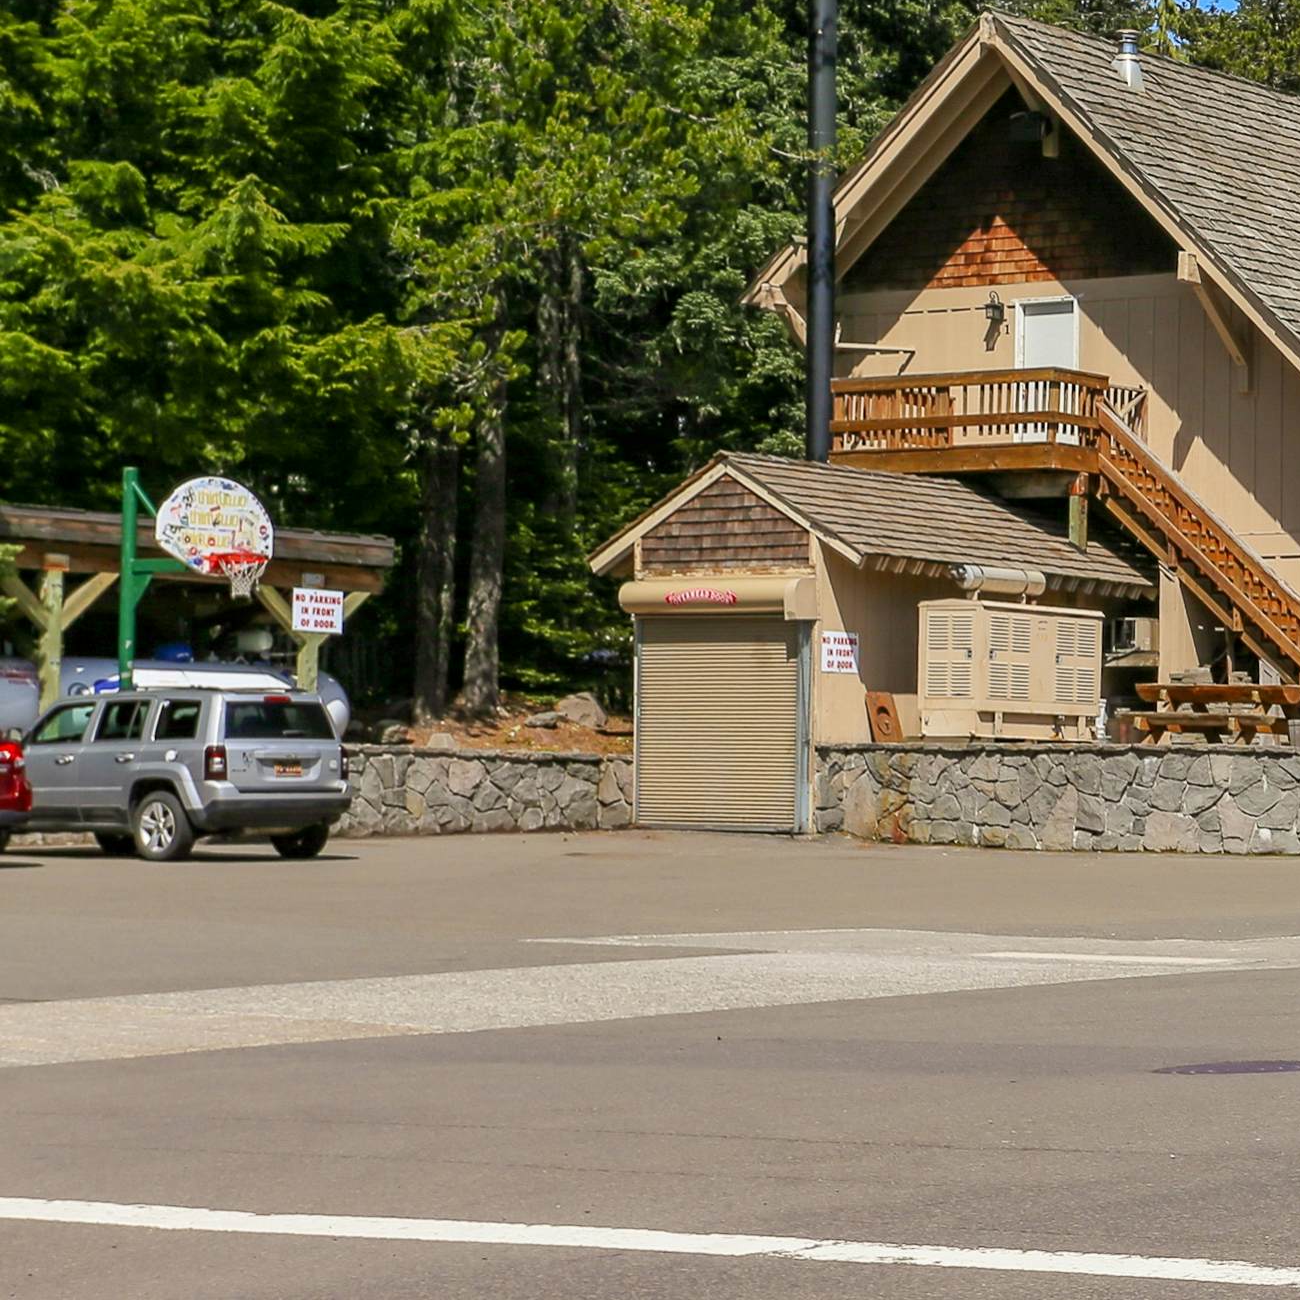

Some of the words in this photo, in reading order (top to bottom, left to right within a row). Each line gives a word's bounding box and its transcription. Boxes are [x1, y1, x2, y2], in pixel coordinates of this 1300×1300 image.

[295, 593, 306, 602] NO
[310, 595, 341, 605] PARKING
[301, 606, 309, 615] IN
[312, 607, 335, 617] FRONT
[301, 619, 310, 627] OF
[821, 636, 831, 644] NO
[833, 637, 857, 646] PARKING
[836, 649, 854, 657] FRONT
[827, 660, 834, 668] OF
